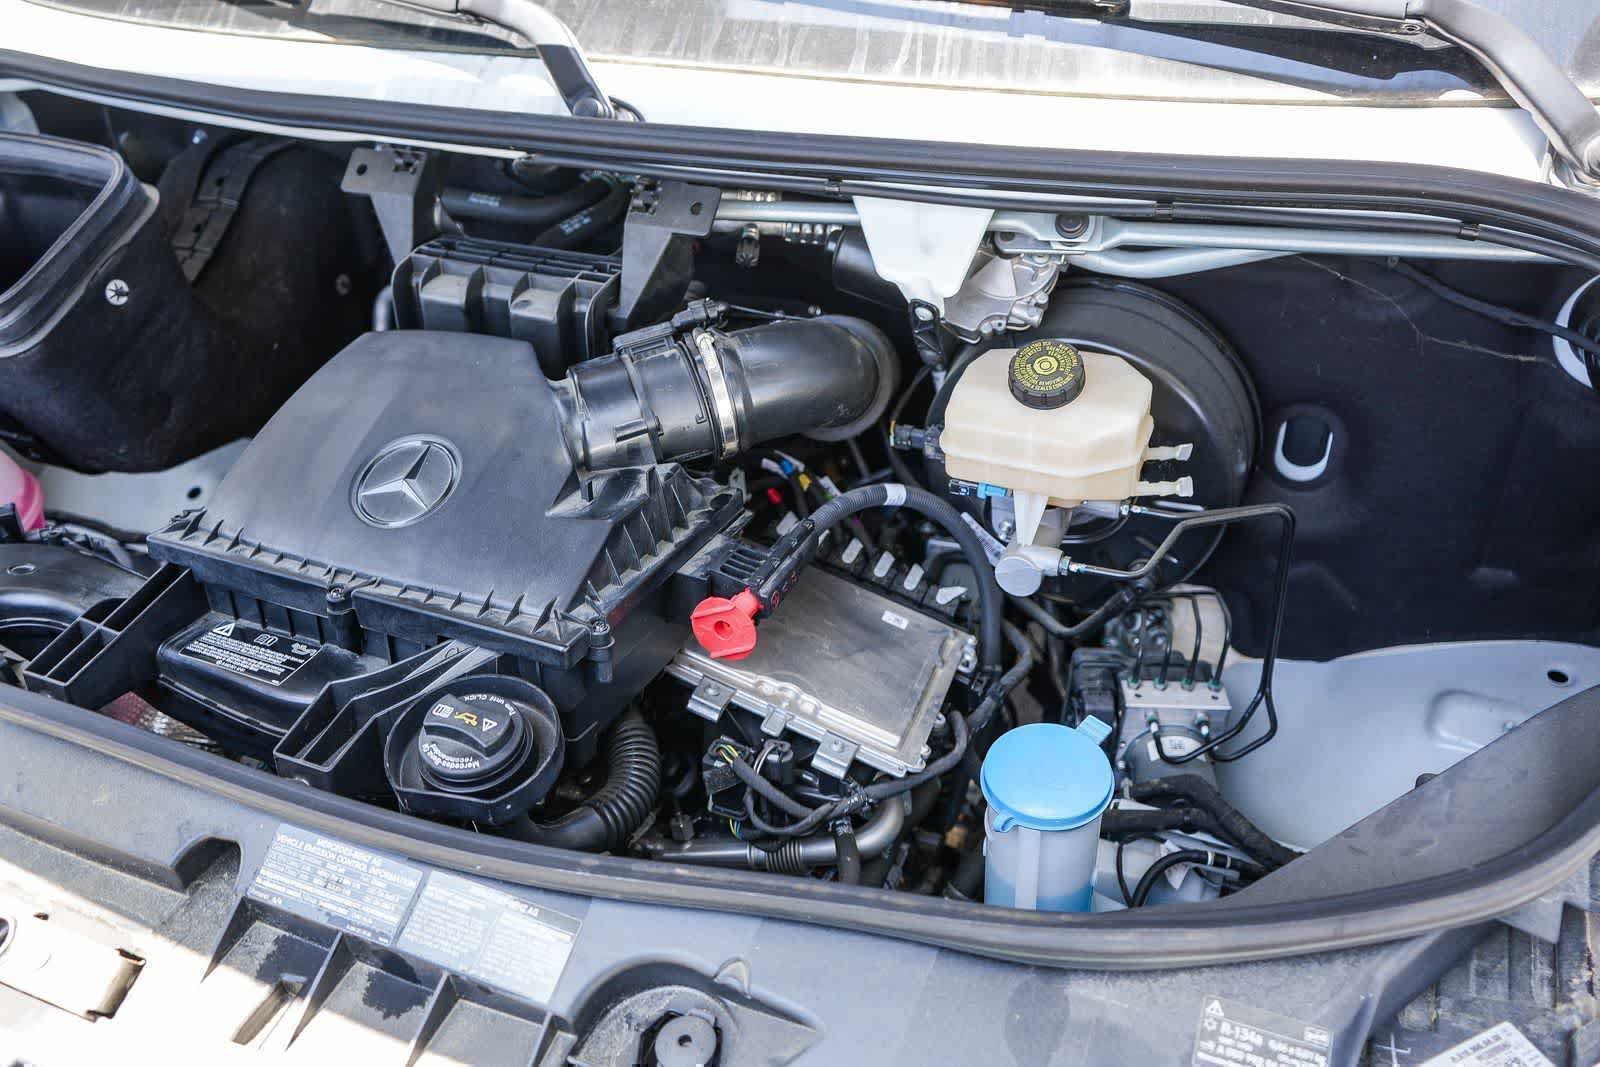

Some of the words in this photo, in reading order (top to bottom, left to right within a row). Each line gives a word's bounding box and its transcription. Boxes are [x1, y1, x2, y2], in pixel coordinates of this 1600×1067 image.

[463, 694, 488, 702] CLICK
[276, 833, 305, 849] VEHICLE
[336, 853, 369, 871] CONTROL
